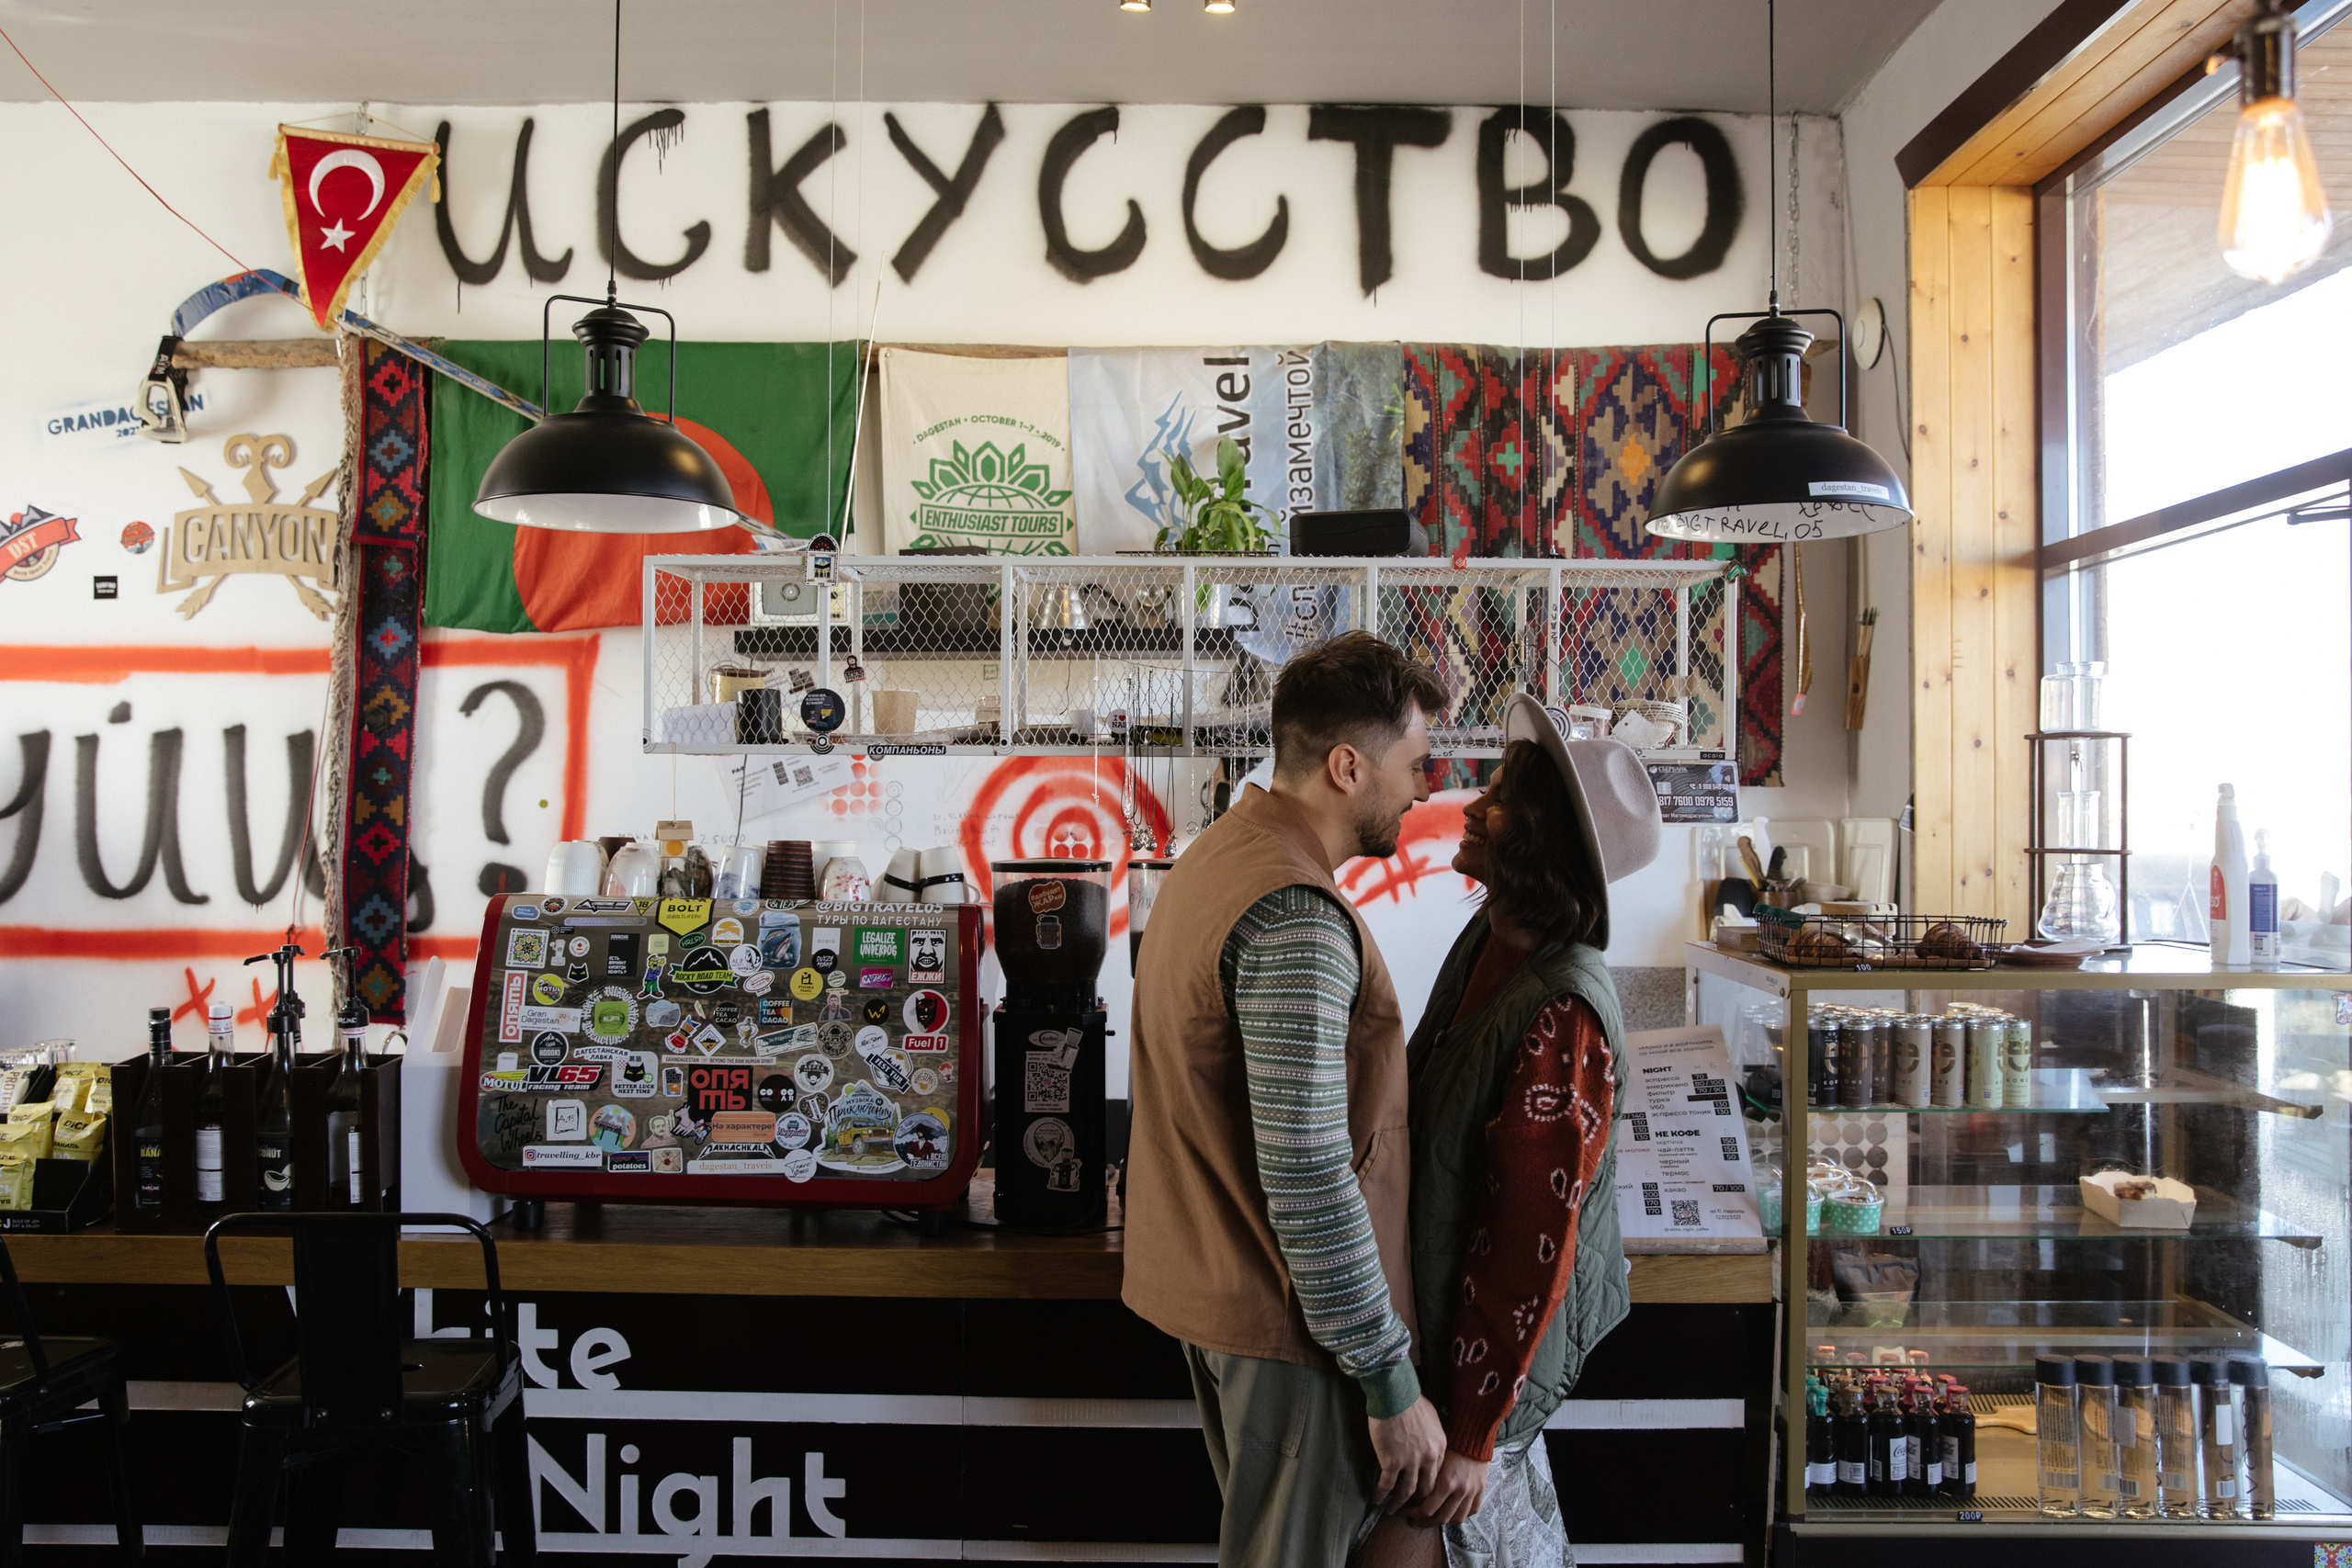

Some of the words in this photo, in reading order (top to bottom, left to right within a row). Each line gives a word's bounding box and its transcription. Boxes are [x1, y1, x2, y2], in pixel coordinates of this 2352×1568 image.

[916, 417, 961, 442] DAGESTAN
[970, 414, 1016, 427] OCTOBER
[1041, 432, 1061, 448] 2019
[1821, 482, 1883, 496] dagestan_travels
[924, 509, 1009, 533] ENTHUSIAST
[1011, 515, 1058, 533] TOURS
[182, 512, 328, 565] CANYON
[6, 531, 39, 560] DST
[868, 745, 945, 755] КОМПАНЬОНЫ
[1658, 795, 1671, 807] 817
[1673, 795, 1693, 807] 7600
[1695, 796, 1715, 807] 0978
[1716, 796, 1734, 807] 5159
[1031, 886, 1061, 901] #дабудет
[667, 904, 703, 912] BOLT
[815, 901, 944, 914] @BIGTRAVEL05
[817, 914, 849, 926] ТУРЫ
[852, 915, 868, 926] ПО
[872, 916, 943, 927] ДАГЕСТАНУ
[862, 931, 897, 944] LEGALIZE
[859, 943, 898, 958] UNDERDOG
[675, 972, 695, 982] ROCKY
[696, 971, 714, 980] ROAD
[716, 970, 733, 980] TEAM
[910, 971, 944, 982] ЕЖЖИ
[526, 1010, 548, 1018] Gran
[521, 1015, 560, 1025] Dagestan
[908, 1038, 932, 1048] Fuel
[938, 1038, 944, 1048] 1
[574, 1047, 629, 1057] ДАГЕСТАНСКАЯ
[528, 1065, 602, 1083] VL65
[1642, 1066, 1673, 1075] NIGHT
[889, 1069, 904, 1084] TUR
[1644, 1076, 1680, 1084] эспрессо
[482, 1077, 526, 1091] MOTUL
[1645, 1082, 1689, 1090] американо
[494, 1094, 519, 1112] The
[845, 1098, 875, 1106] МУЗЫКА
[494, 1098, 540, 1134] Capital
[1651, 1110, 1688, 1118] эспрессо
[725, 1122, 775, 1131] характере!
[501, 1122, 544, 1153] Wheels
[1670, 1129, 1702, 1137] КОФЕ
[537, 1150, 601, 1160] travelling_kbr
[612, 1162, 647, 1170] potatoes
[698, 1161, 774, 1172] dagestan_travels
[1658, 1157, 1690, 1167] черный
[1661, 1169, 1690, 1178] термос
[526, 1432, 847, 1568] Night
